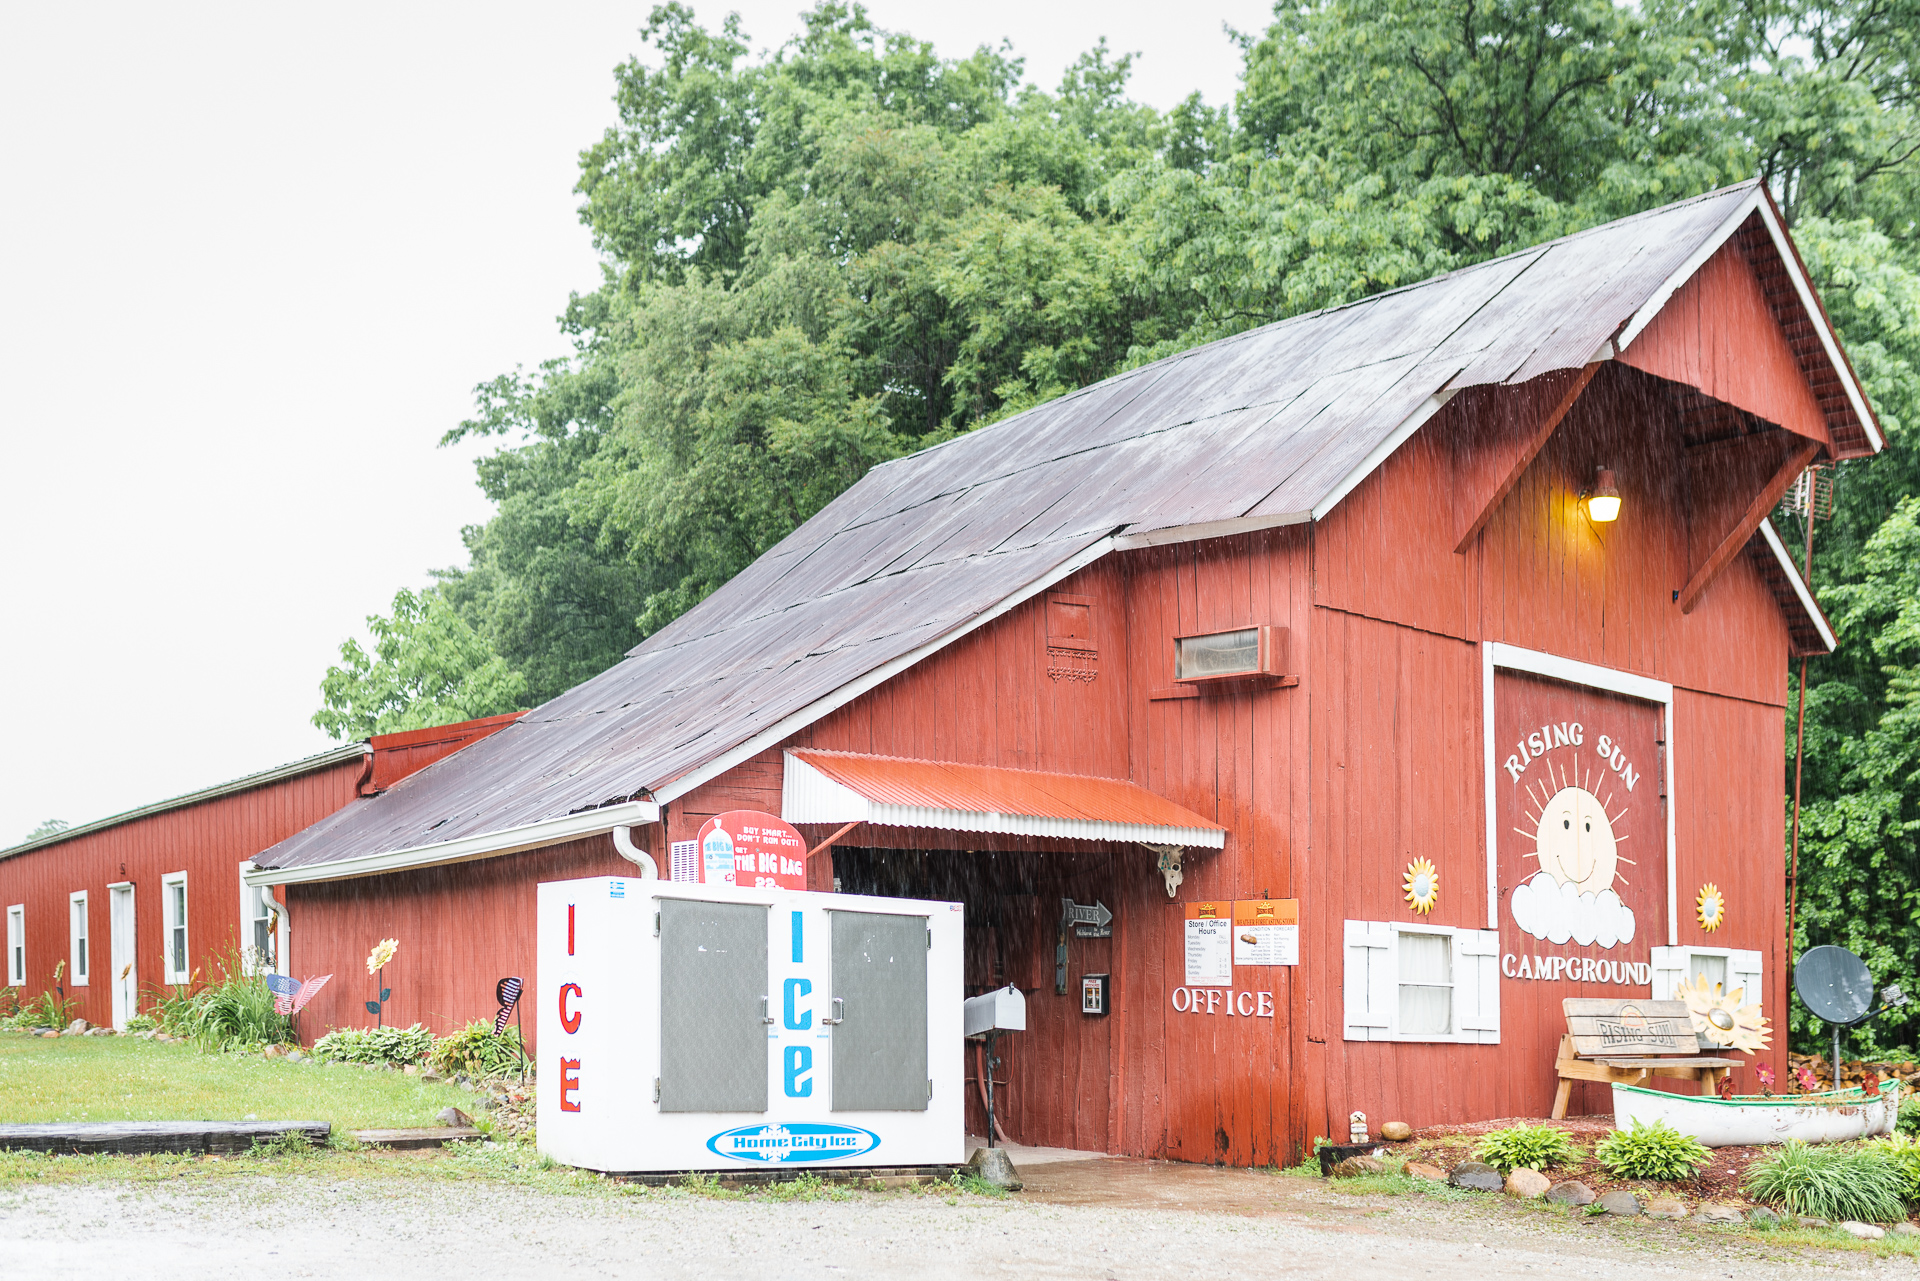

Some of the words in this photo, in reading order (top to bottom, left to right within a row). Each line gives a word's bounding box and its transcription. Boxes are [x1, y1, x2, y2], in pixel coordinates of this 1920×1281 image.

[1504, 722, 1584, 783] RISING
[1596, 735, 1640, 792] SUN
[737, 834, 760, 842] DON'T
[763, 836, 778, 844] RUN
[735, 854, 755, 872] THE
[759, 853, 777, 873] BIG
[780, 856, 802, 876] BAG
[1068, 907, 1100, 922] RIVER
[1189, 920, 1204, 928] Store
[1502, 953, 1652, 985] CAMPGROUND
[558, 895, 582, 1112] ICE
[1172, 987, 1274, 1017] OFFICE
[1600, 1024, 1643, 1045] RISING
[1647, 1024, 1675, 1045] SUN
[734, 1137, 788, 1148] Home
[792, 1136, 826, 1149] City
[830, 1136, 857, 1146] Ice
